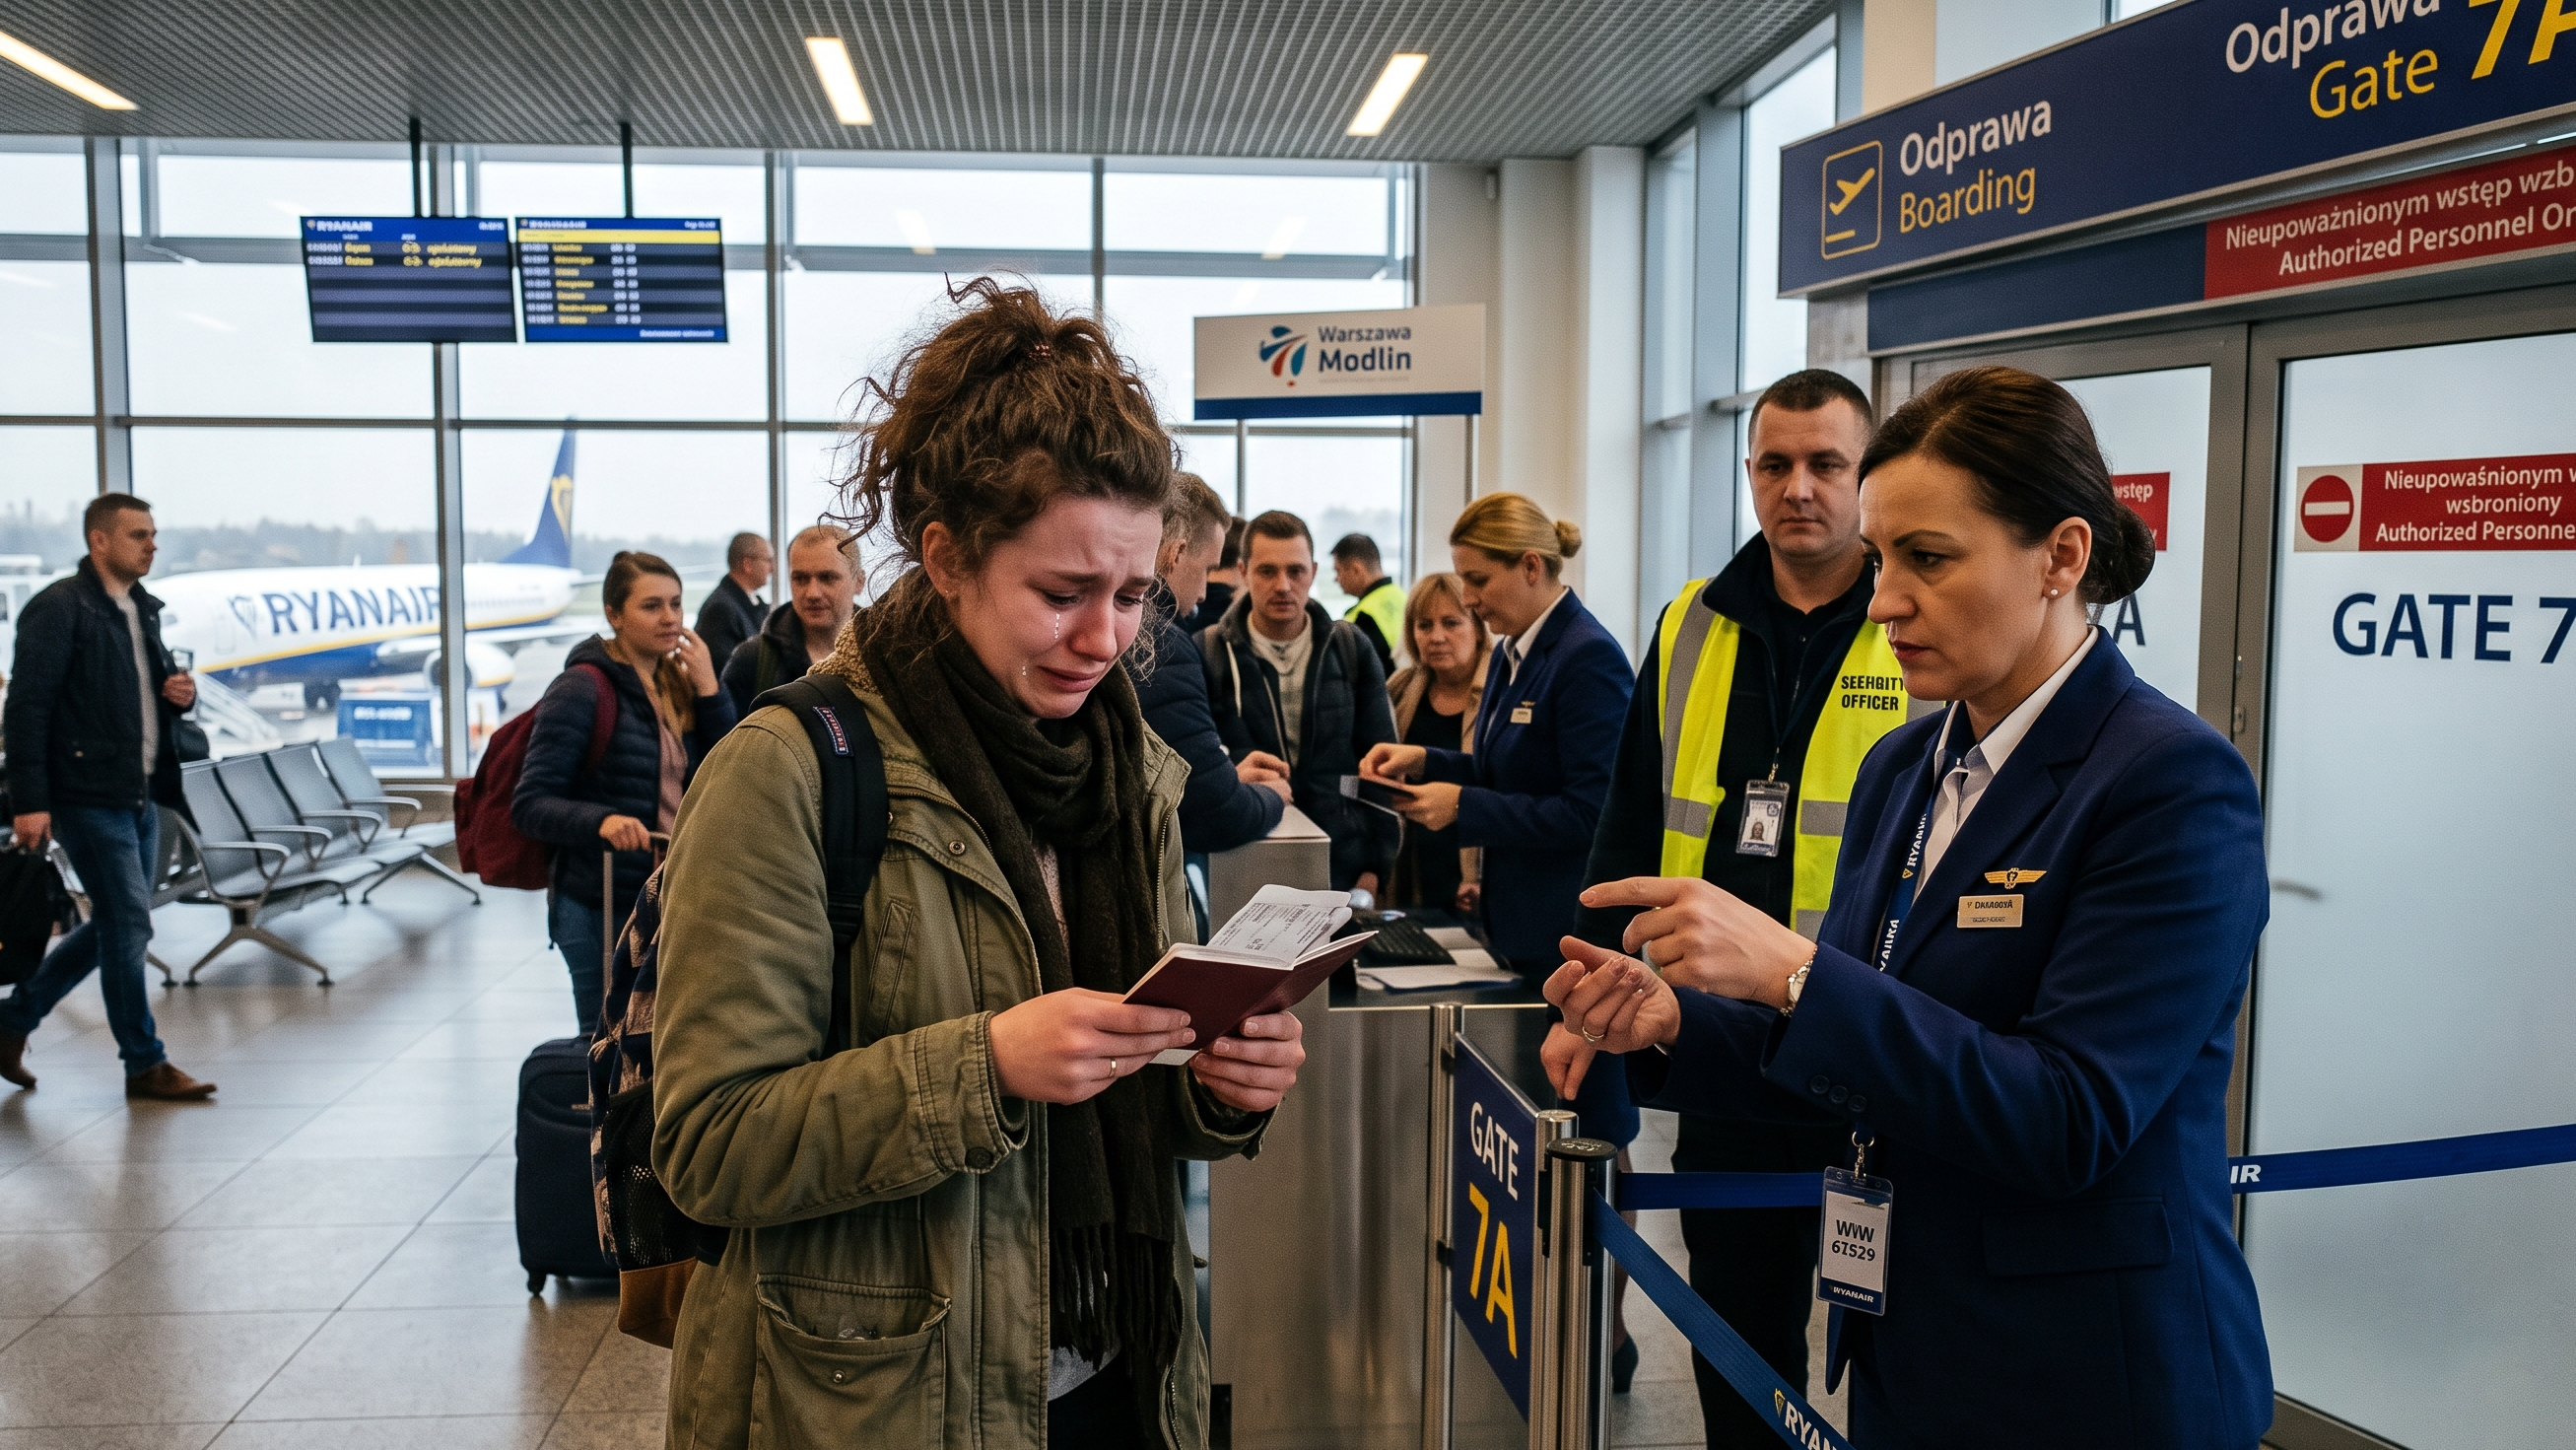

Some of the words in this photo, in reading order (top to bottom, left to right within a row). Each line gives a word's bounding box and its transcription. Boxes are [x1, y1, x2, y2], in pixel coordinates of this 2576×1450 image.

[2310, 49, 2438, 118] Gate
[1900, 101, 2051, 175] Odprawa
[1900, 168, 2035, 233] Boarding
[2226, 194, 2429, 249] Nieupoważnionym
[2436, 177, 2512, 209] wstęp
[2278, 230, 2402, 275] Authorized
[2408, 206, 2534, 253] Personnel
[1319, 326, 1412, 343] Warszawa
[1319, 347, 1411, 373] Modlin
[2385, 465, 2562, 493] Nieupowaśnionym
[2446, 492, 2562, 517] wsbroniony
[2376, 520, 2477, 542] Authorized
[2333, 592, 2514, 661] GATE
[1841, 694, 1899, 711] OFFICER
[1470, 1101, 1519, 1202] GATE
[1469, 1181, 1518, 1359] 7A
